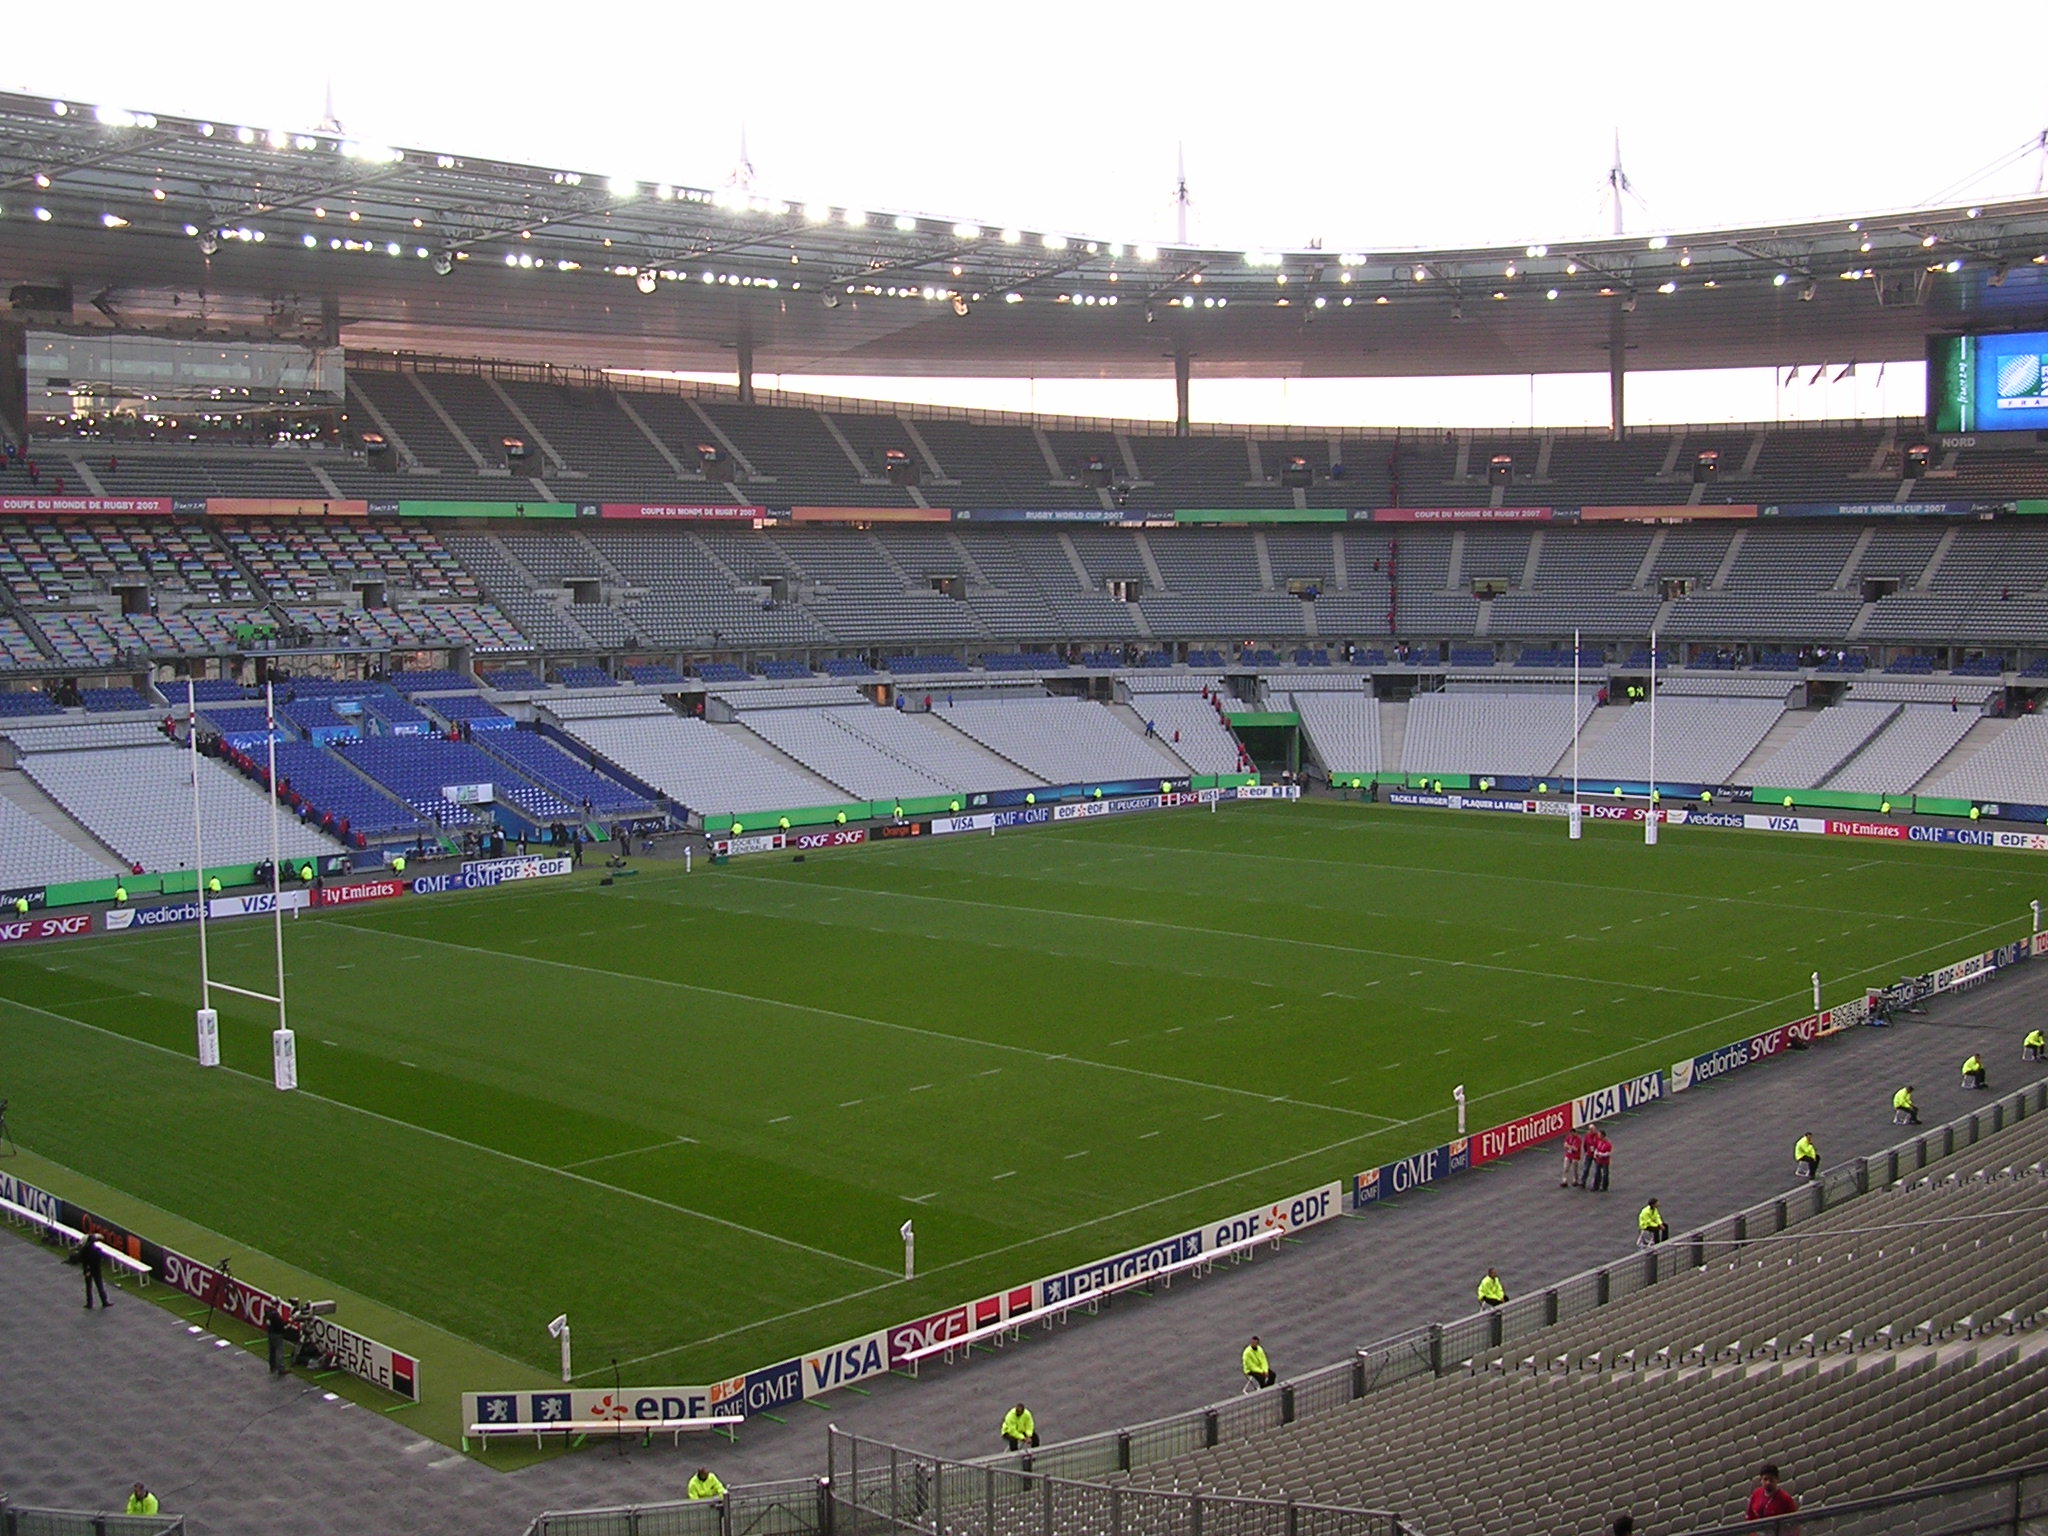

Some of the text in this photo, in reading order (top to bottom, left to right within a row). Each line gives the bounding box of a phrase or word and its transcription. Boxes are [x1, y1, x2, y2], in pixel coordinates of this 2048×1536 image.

[1942, 438, 1976, 447] NORD
[3, 500, 159, 511] COUPE DU MONDE DE RUGBY 2007
[640, 507, 665, 515] COUPE
[666, 507, 677, 515] DU
[704, 508, 714, 516] DE
[715, 508, 738, 516] RUGBY
[739, 508, 757, 516] 2007
[1025, 511, 1125, 519] RUGBY WORLD CUP 2007
[1414, 510, 1440, 518] COUPE
[1441, 510, 1452, 518] DU
[1453, 510, 1481, 518] MONDE
[1482, 510, 1493, 518] DE
[1494, 510, 1520, 518] RUGBY
[1839, 504, 1946, 514] RUGBY WORLD CUP 2007
[1117, 798, 1150, 809] PEUGEOT
[1494, 801, 1504, 809] LA
[951, 816, 974, 831] VISA
[994, 807, 1049, 826] GMF GMF
[1595, 806, 1666, 822] SNCF SNF
[1689, 812, 1743, 828] vediorbis
[1768, 817, 1800, 830] VISA
[799, 829, 864, 849] SNCF SNCF
[1832, 821, 1900, 837] Fly Emirates
[1908, 825, 1993, 845] GMF GMF
[414, 870, 500, 894] GMF GMF
[322, 883, 395, 903] Fly Emirates
[242, 894, 279, 913] VISA
[137, 903, 209, 925] vediorbis
[0, 916, 89, 940] NCF SNCF
[1998, 942, 2018, 968] GMF
[1751, 1030, 1782, 1061] SNCF
[1694, 1043, 1749, 1082] vediorbis
[1578, 1073, 1660, 1123] VISA VISA
[1482, 1111, 1564, 1156] Fly Emirates
[1392, 1149, 1439, 1193] GMF
[20, 1183, 58, 1223] VISA
[1360, 1186, 1378, 1202] GMF
[165, 1255, 214, 1297] SNCF
[1073, 1244, 1177, 1295] PEUGEOT
[312, 1319, 373, 1361] OCIETE
[892, 1311, 965, 1362] SNCF
[806, 1339, 882, 1390] VISA
[749, 1371, 799, 1409] GMF
[714, 1399, 743, 1418] GMF
